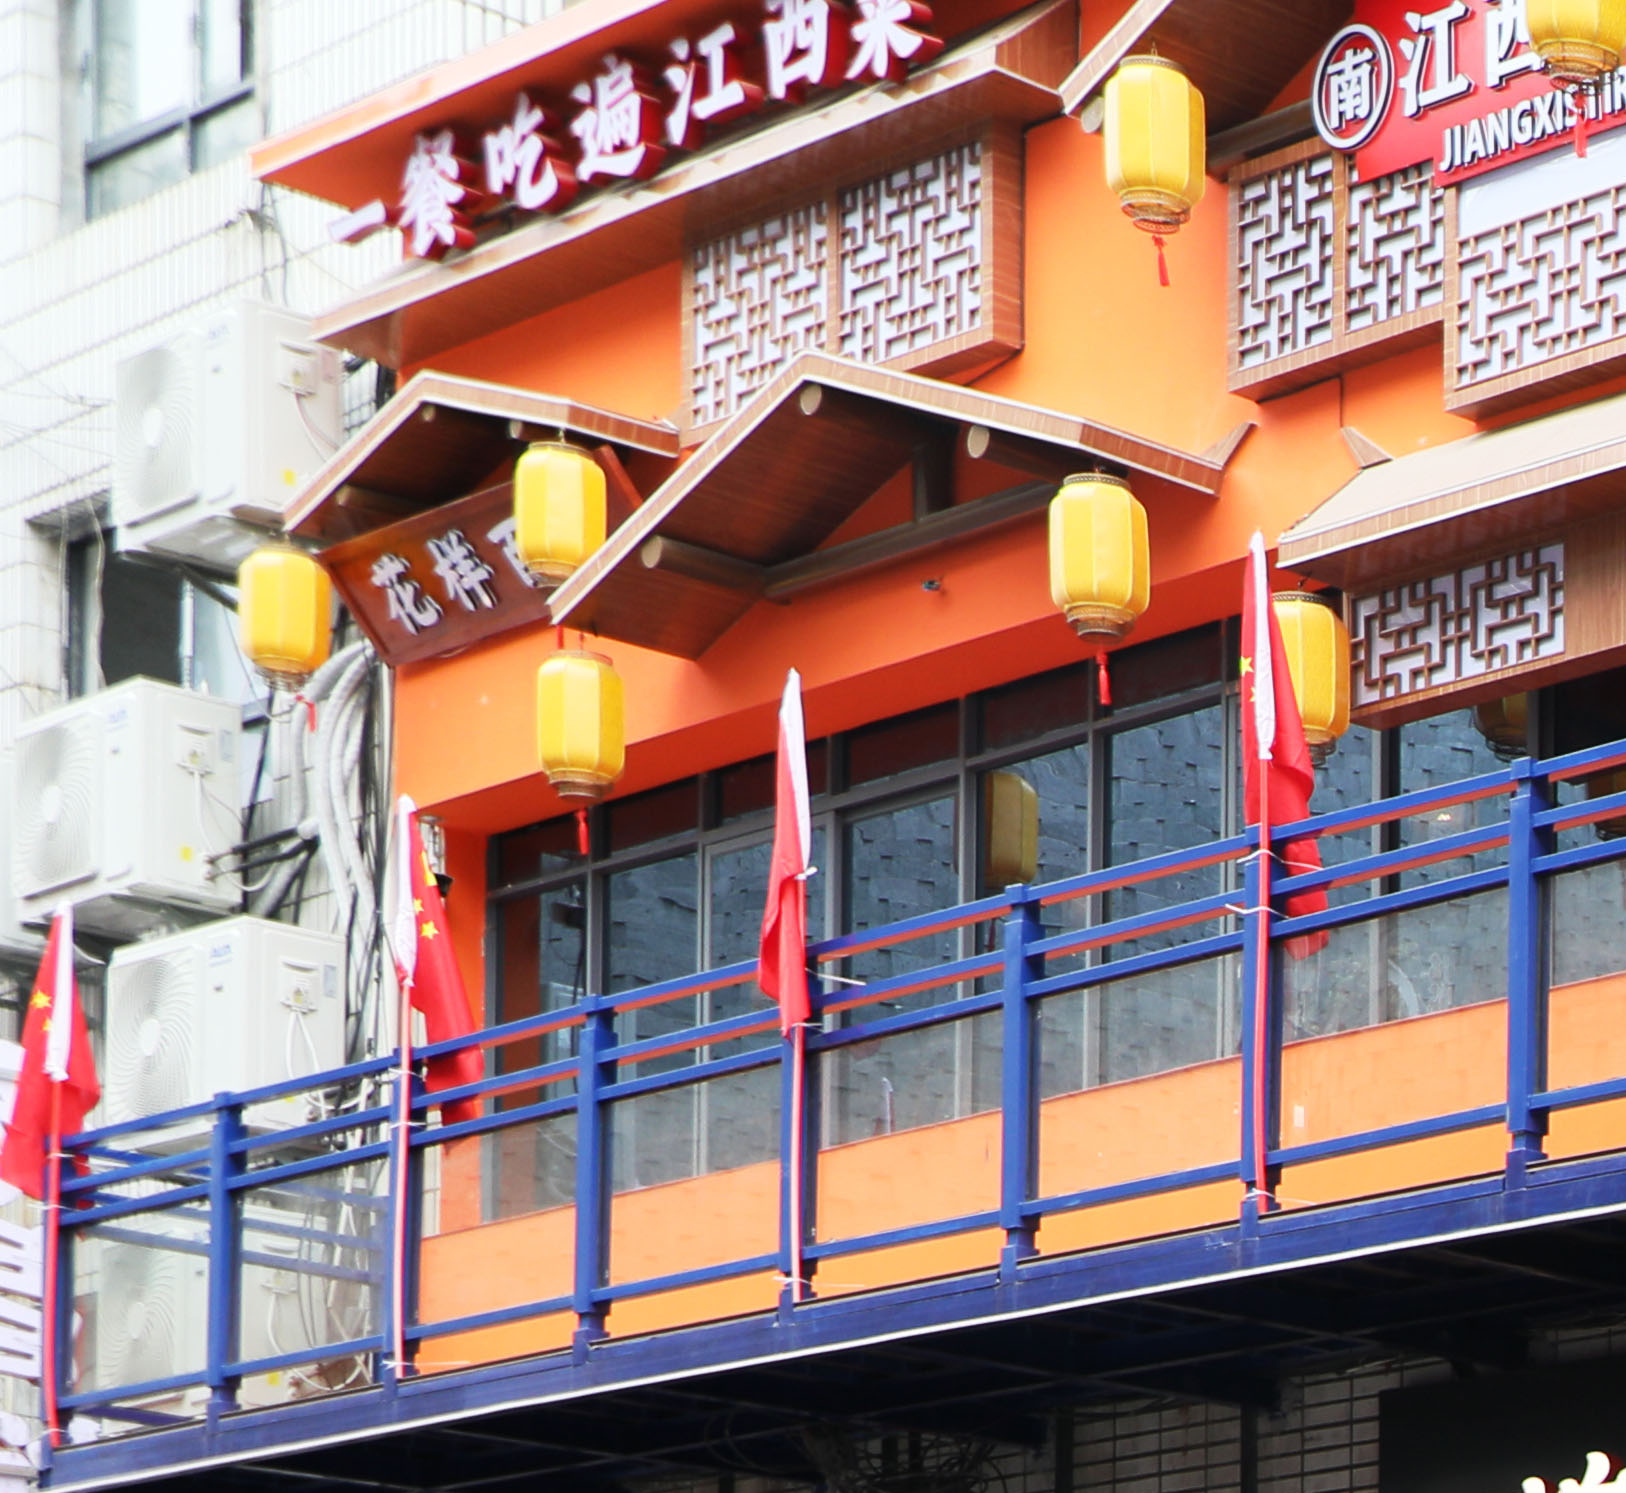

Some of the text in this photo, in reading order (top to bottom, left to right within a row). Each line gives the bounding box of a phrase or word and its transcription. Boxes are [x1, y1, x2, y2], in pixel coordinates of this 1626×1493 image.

[327, 0, 924, 257] 一餐吃遍江西菜
[1326, 48, 1376, 130] 南
